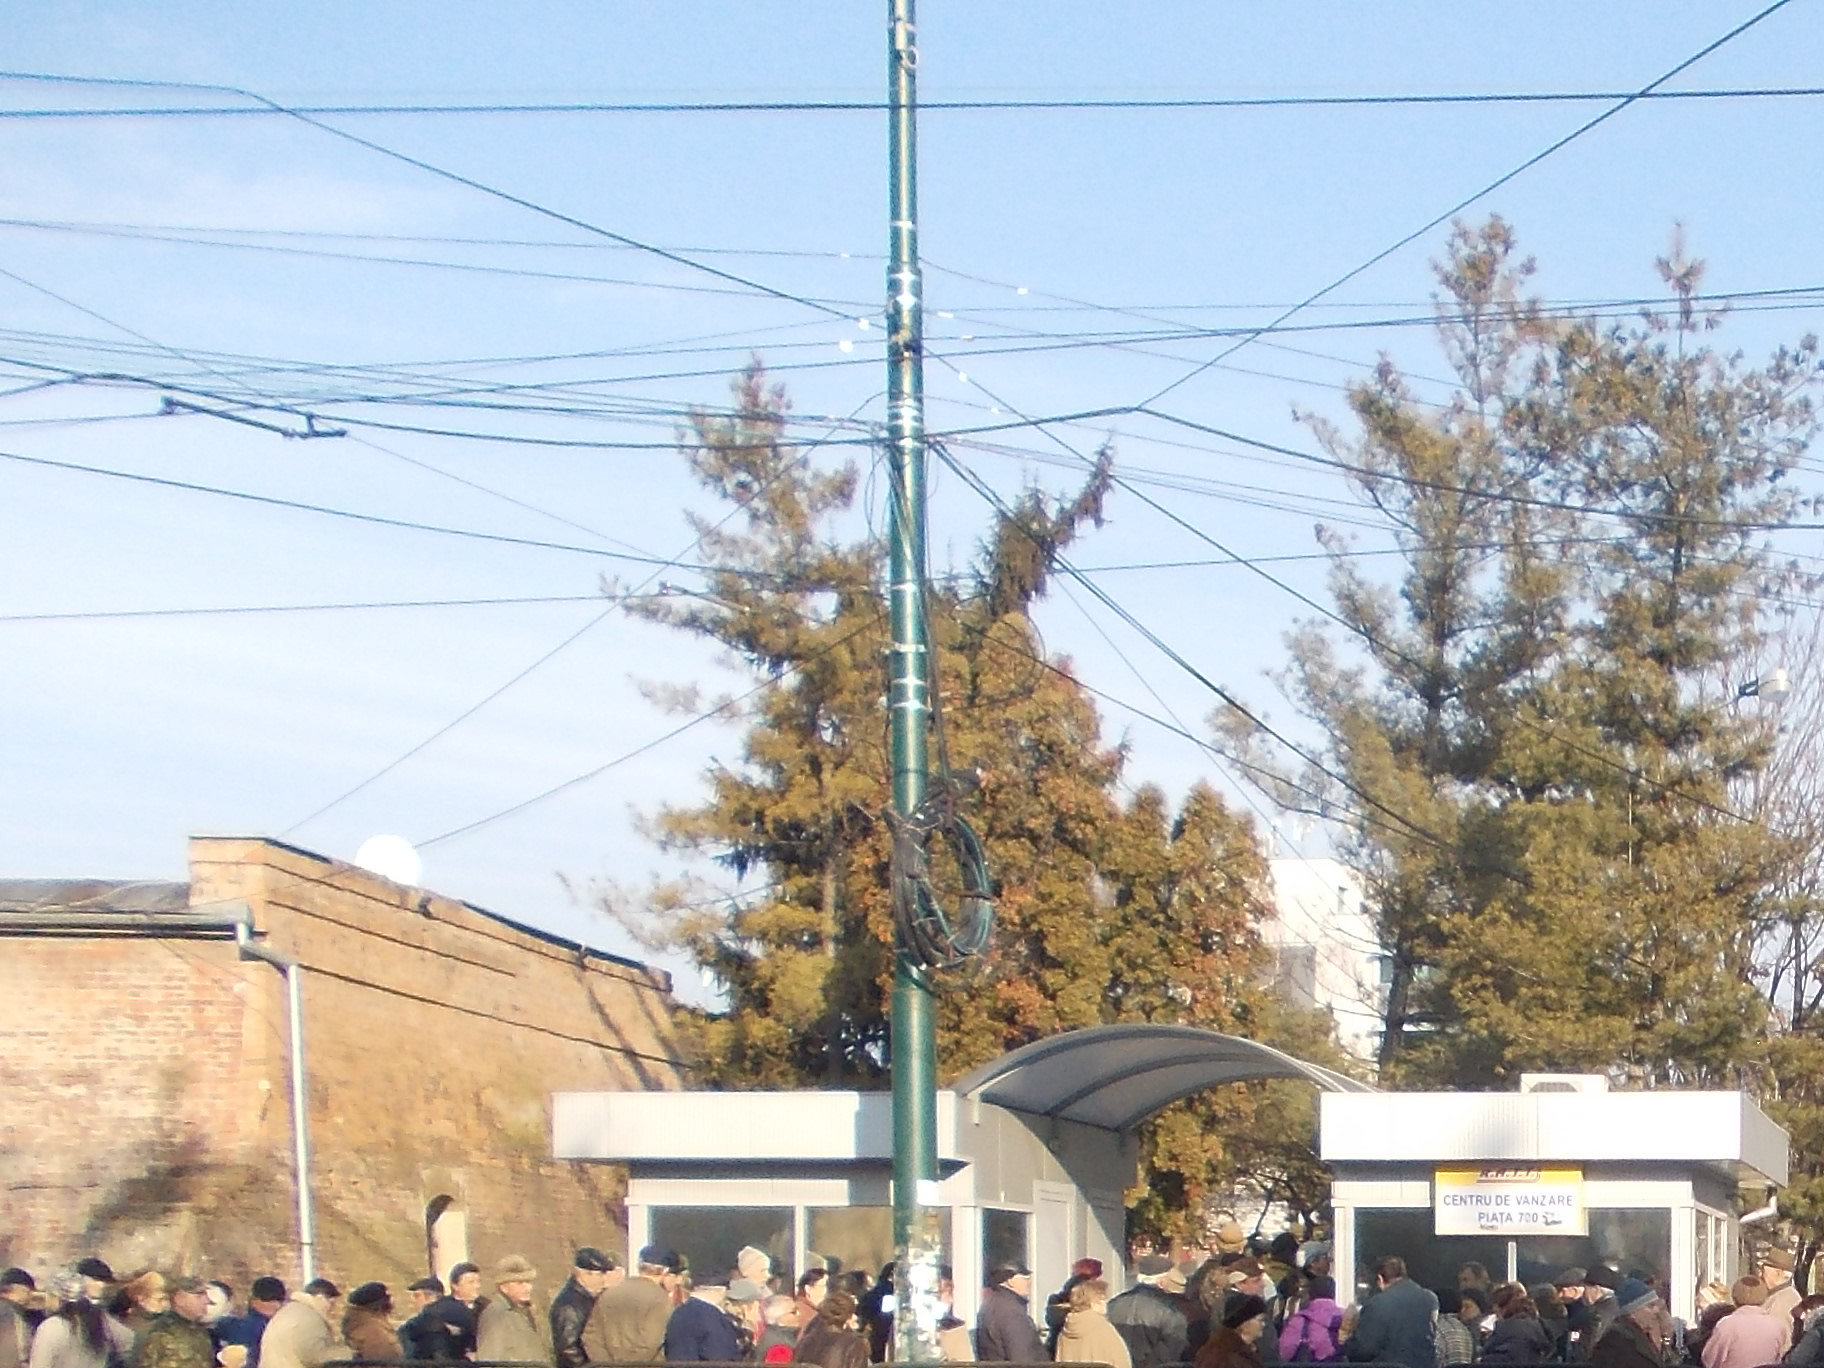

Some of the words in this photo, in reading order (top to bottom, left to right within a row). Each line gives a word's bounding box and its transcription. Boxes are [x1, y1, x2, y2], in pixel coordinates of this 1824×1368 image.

[1443, 1194, 1492, 1207] CENTRU
[1495, 1194, 1511, 1207] DE
[1516, 1194, 1573, 1207] VANZARE
[1518, 1212, 1538, 1223] 700
